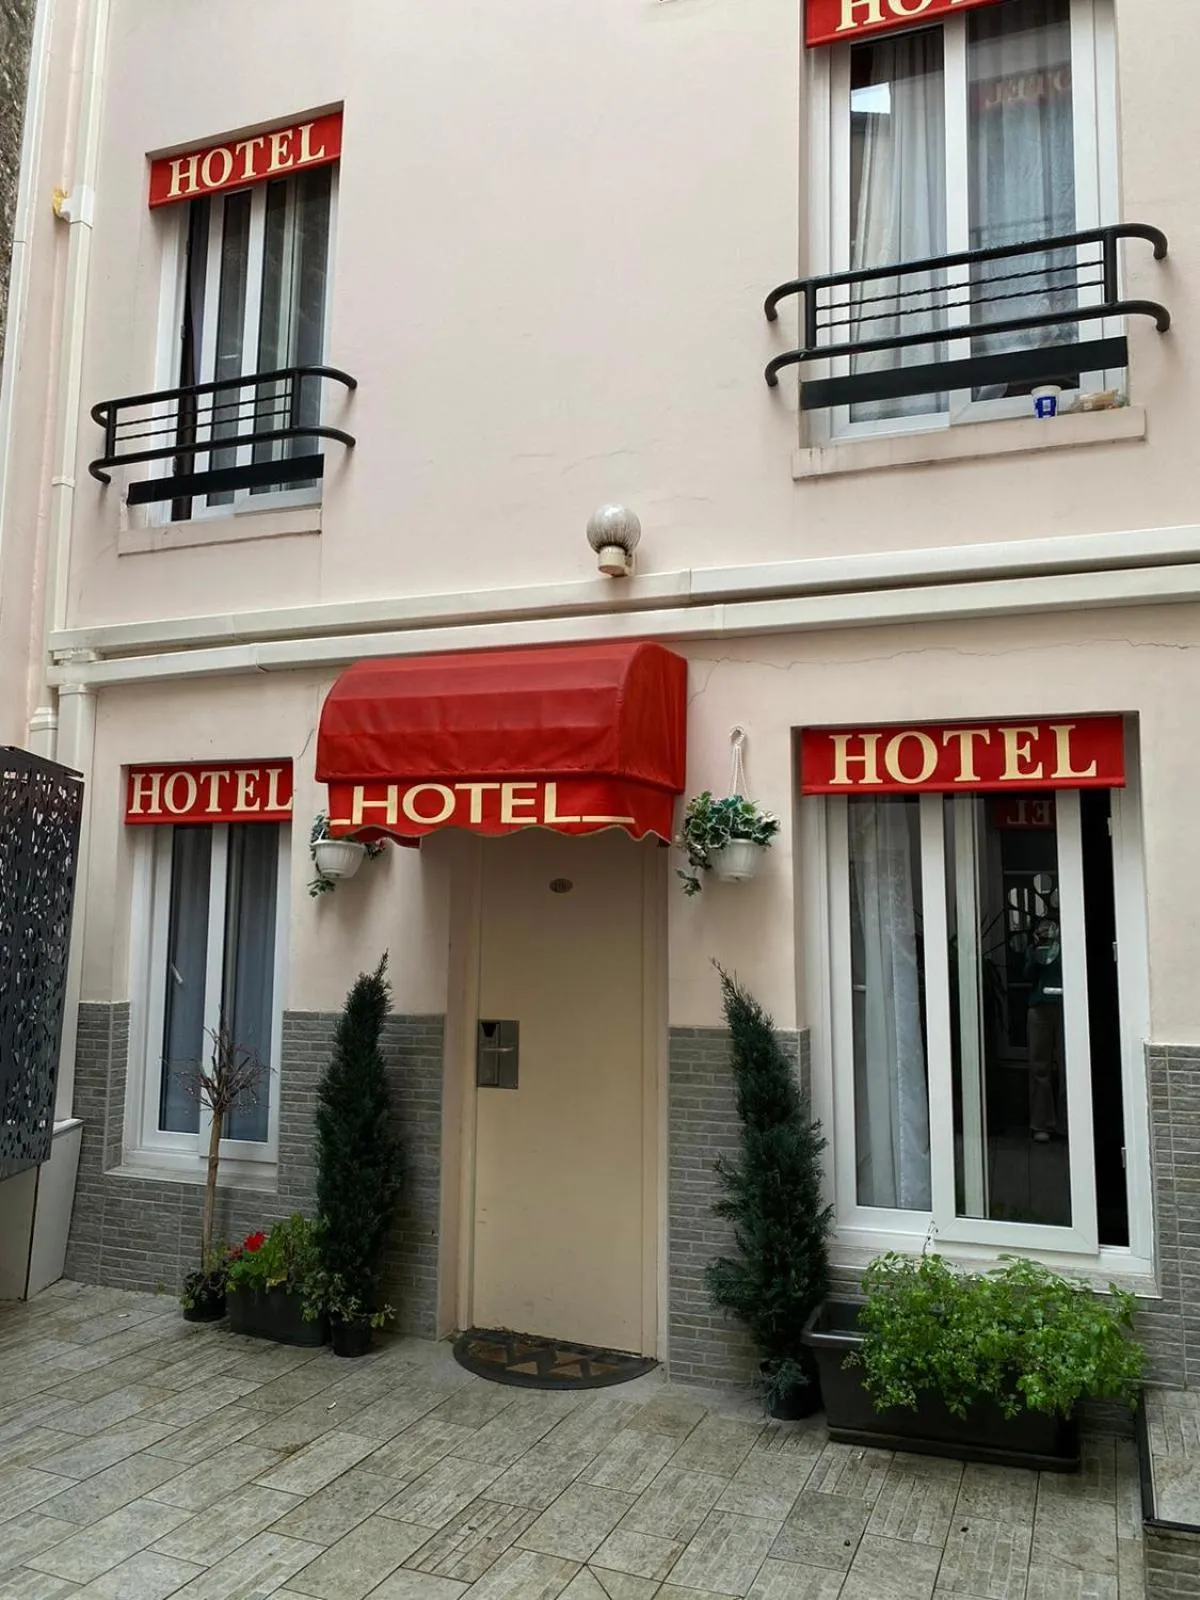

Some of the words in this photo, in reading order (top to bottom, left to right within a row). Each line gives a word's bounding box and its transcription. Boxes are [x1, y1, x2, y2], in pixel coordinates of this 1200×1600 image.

[166, 123, 325, 197] HOTEL
[828, 724, 1097, 784] HOTEL
[128, 769, 293, 814] HOTEL
[352, 782, 581, 825] HOTEL
